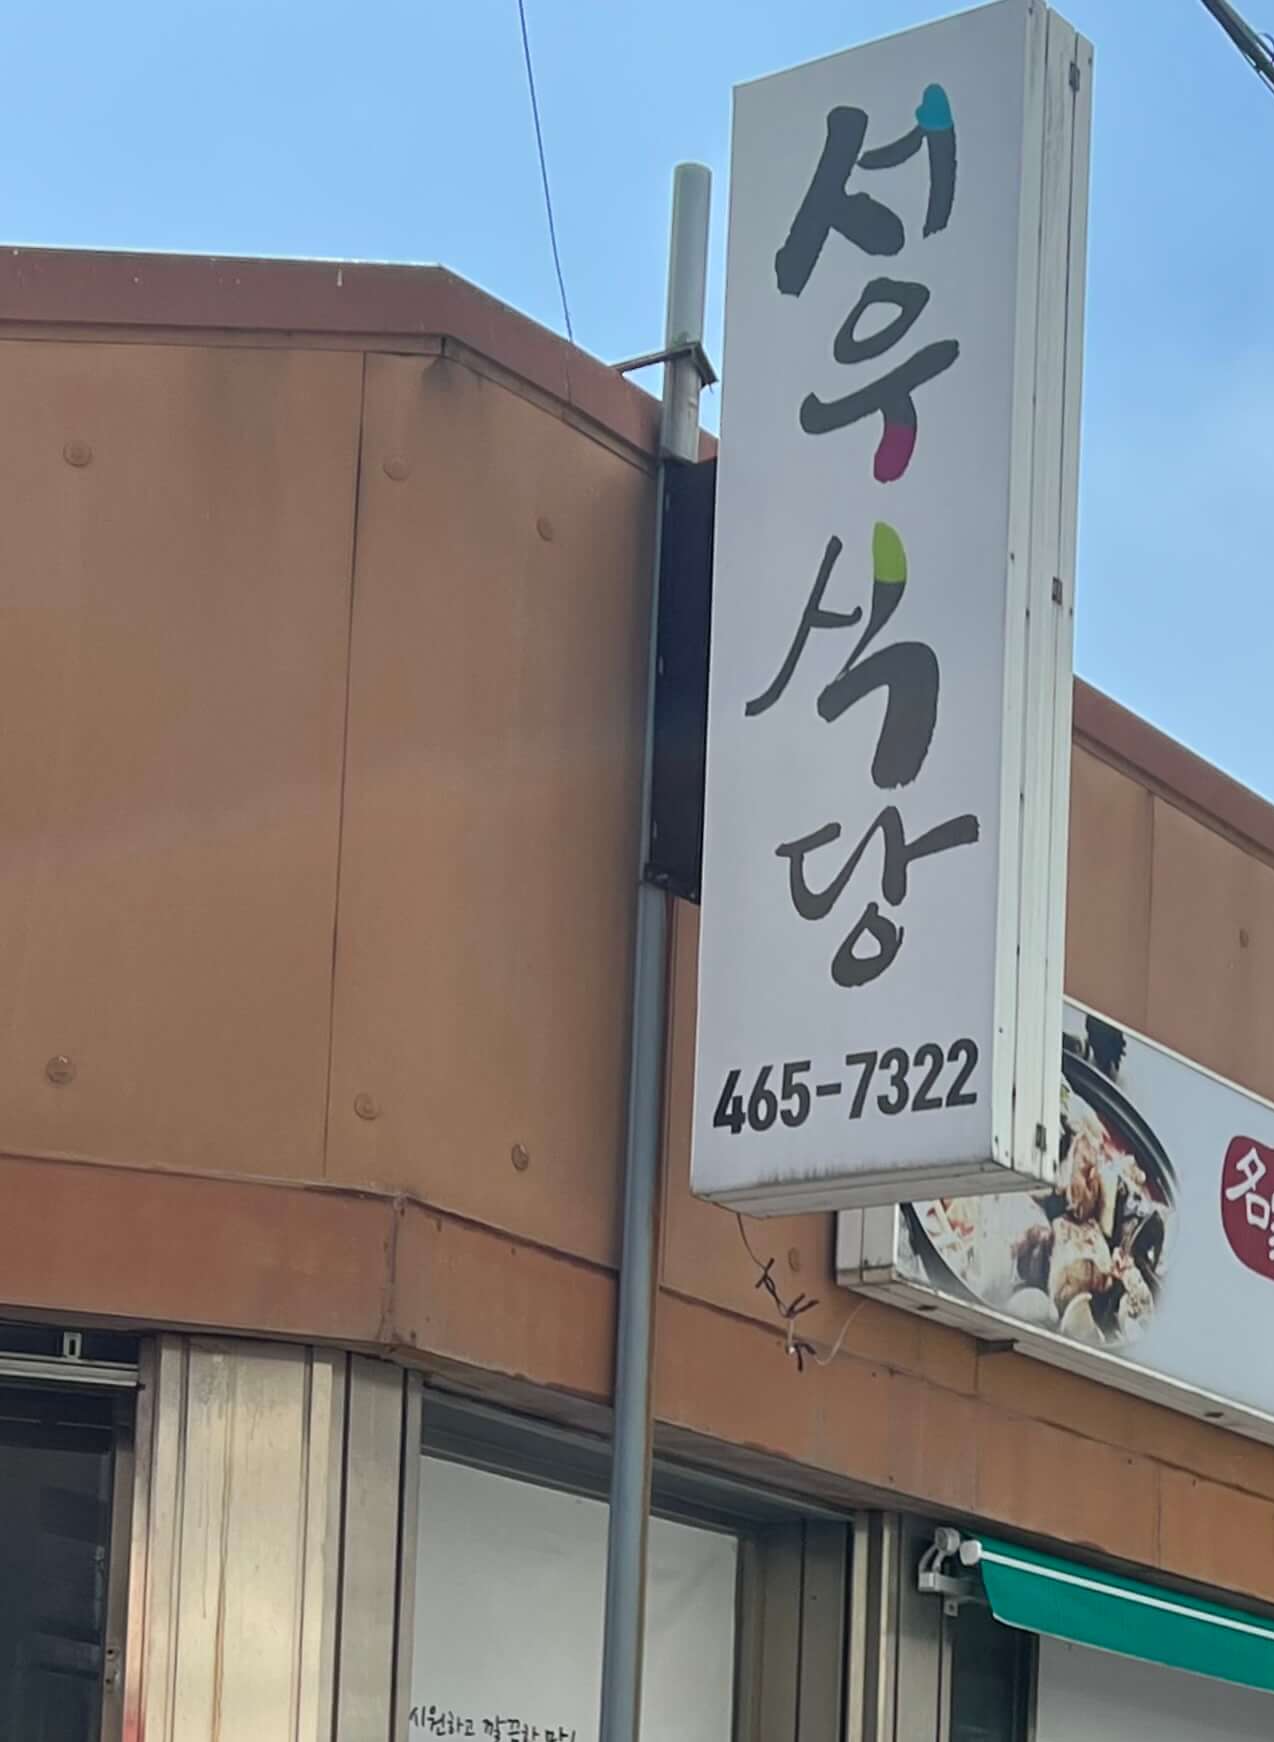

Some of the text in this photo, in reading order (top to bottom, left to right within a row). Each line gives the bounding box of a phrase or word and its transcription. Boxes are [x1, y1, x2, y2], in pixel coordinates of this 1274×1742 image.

[745, 83, 980, 988] 서우식당
[712, 1038, 979, 1135] 465-7322
[409, 1706, 476, 1737] 시원하고
